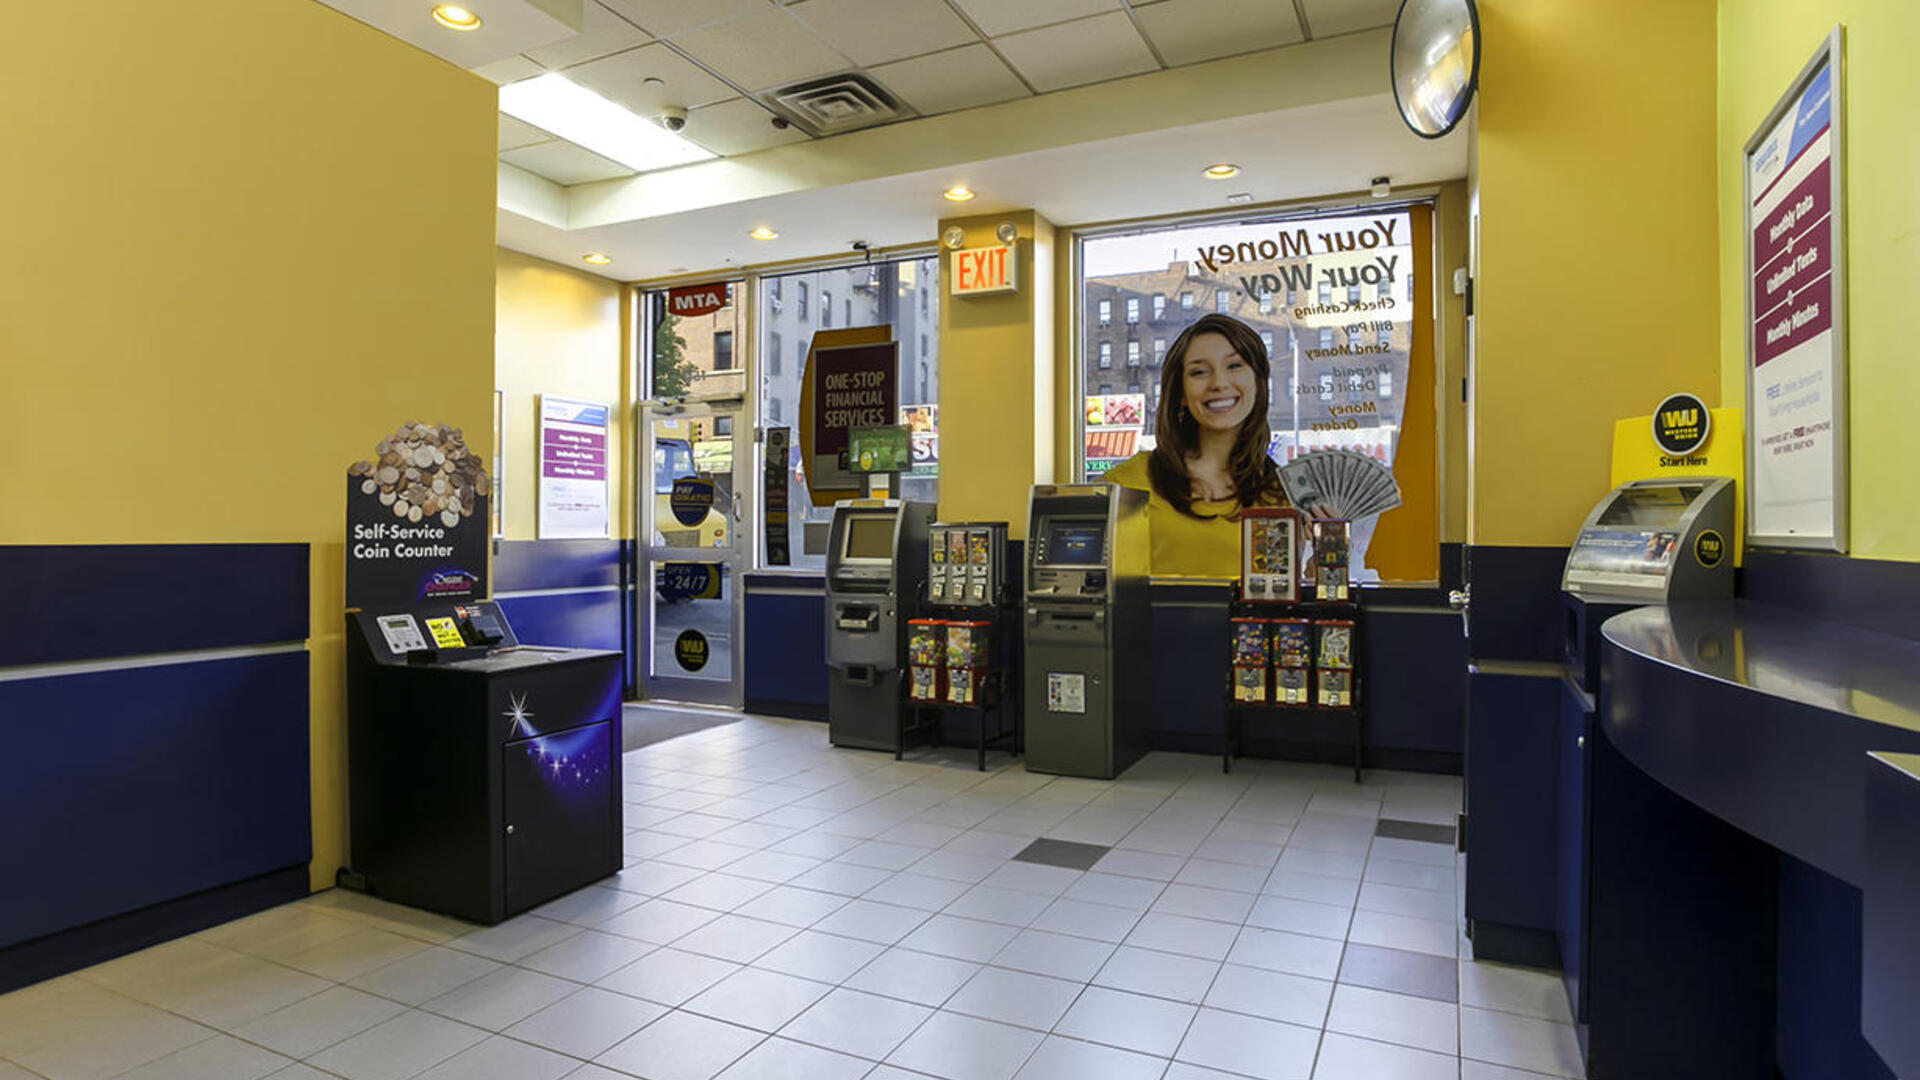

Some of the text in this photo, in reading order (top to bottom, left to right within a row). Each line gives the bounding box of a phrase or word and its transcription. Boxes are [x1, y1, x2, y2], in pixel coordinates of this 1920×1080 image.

[959, 248, 1008, 290] EXIT
[675, 292, 720, 310] MTA
[825, 371, 885, 390] ONE-STOP
[825, 390, 885, 406] FINANCIAL
[825, 408, 884, 428] SERVICES
[1659, 455, 1708, 467] Start Here
[354, 523, 444, 539] Self-Service
[353, 543, 453, 559] Coin Counter
[675, 576, 707, 589] 24/7
